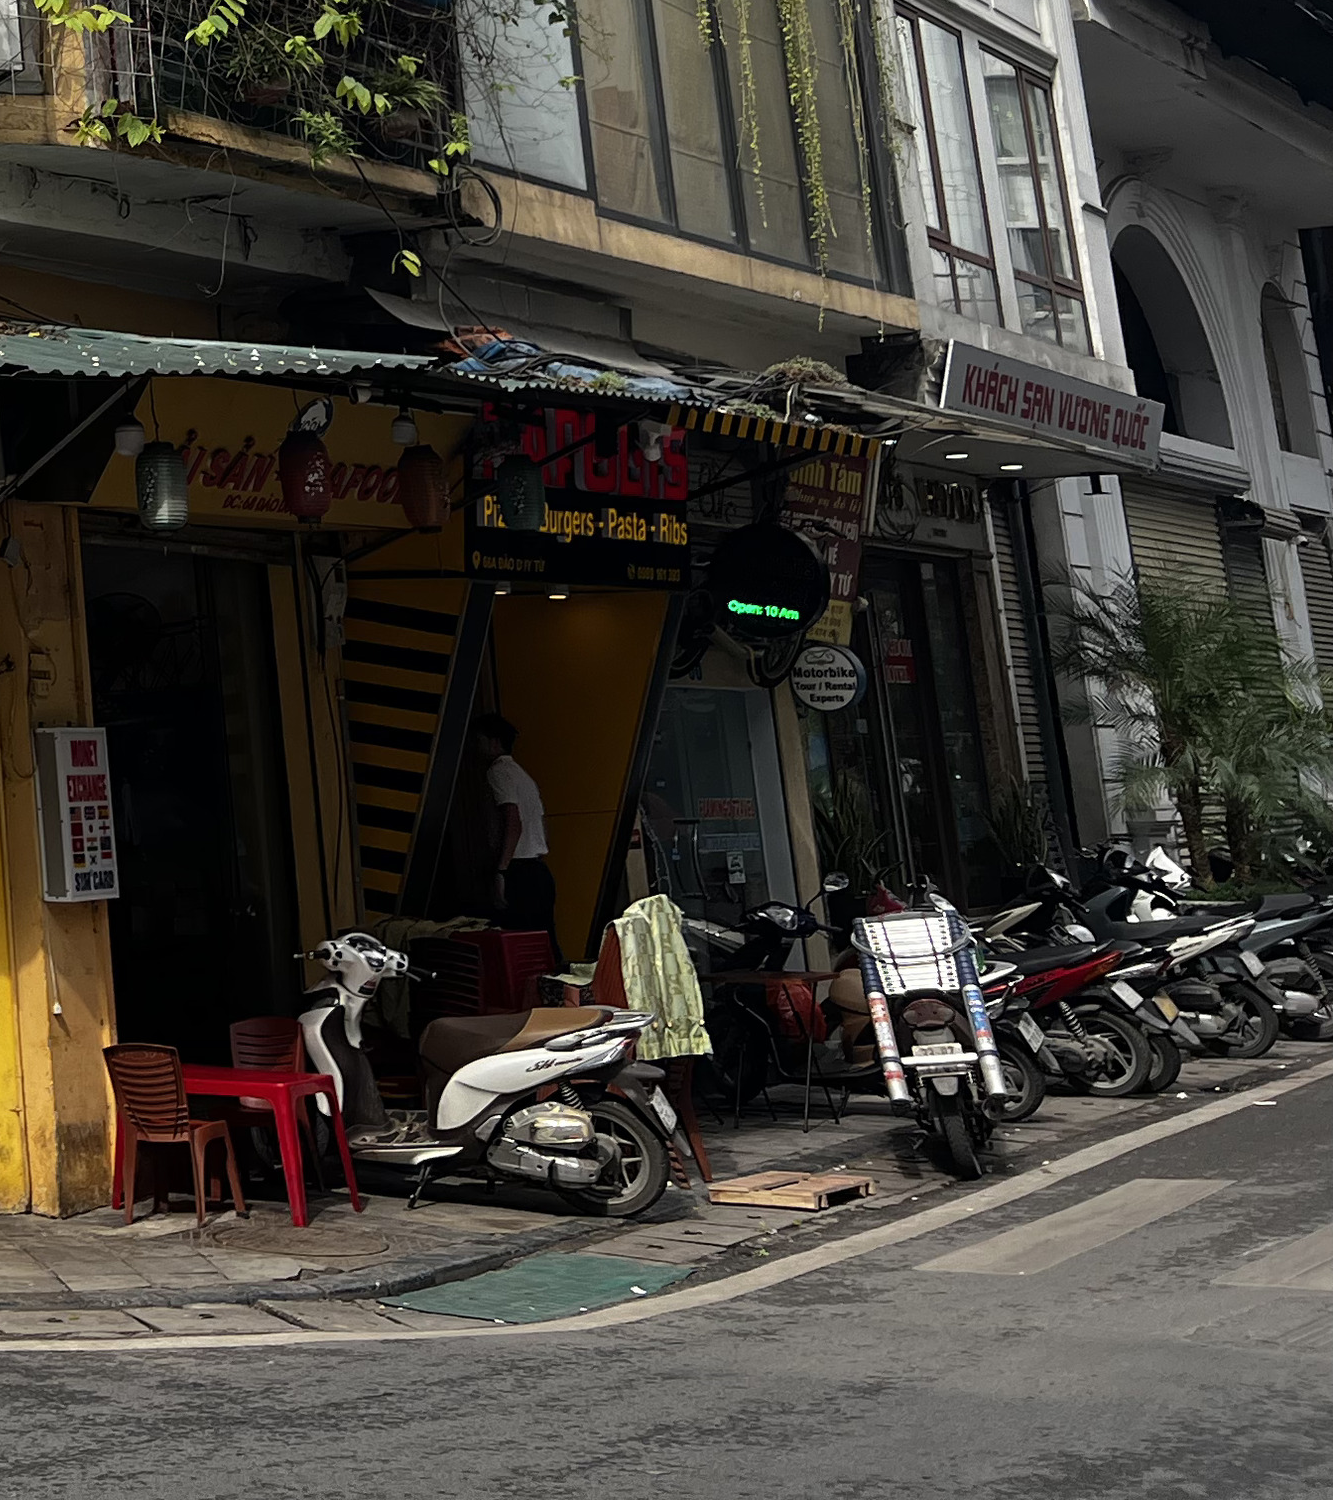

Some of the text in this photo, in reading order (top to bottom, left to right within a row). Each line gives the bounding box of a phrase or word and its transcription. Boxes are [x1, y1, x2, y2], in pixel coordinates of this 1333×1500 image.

[961, 362, 1151, 451] KHÁCH SẠN VƯƠNG QUỐC
[830, 460, 863, 497] Tâm
[608, 507, 647, 542] Pasta
[659, 512, 689, 547] Ribs
[792, 666, 856, 680] Motorbike
[794, 681, 817, 691] Tour
[824, 680, 856, 692] Rental
[809, 693, 845, 704] Experts
